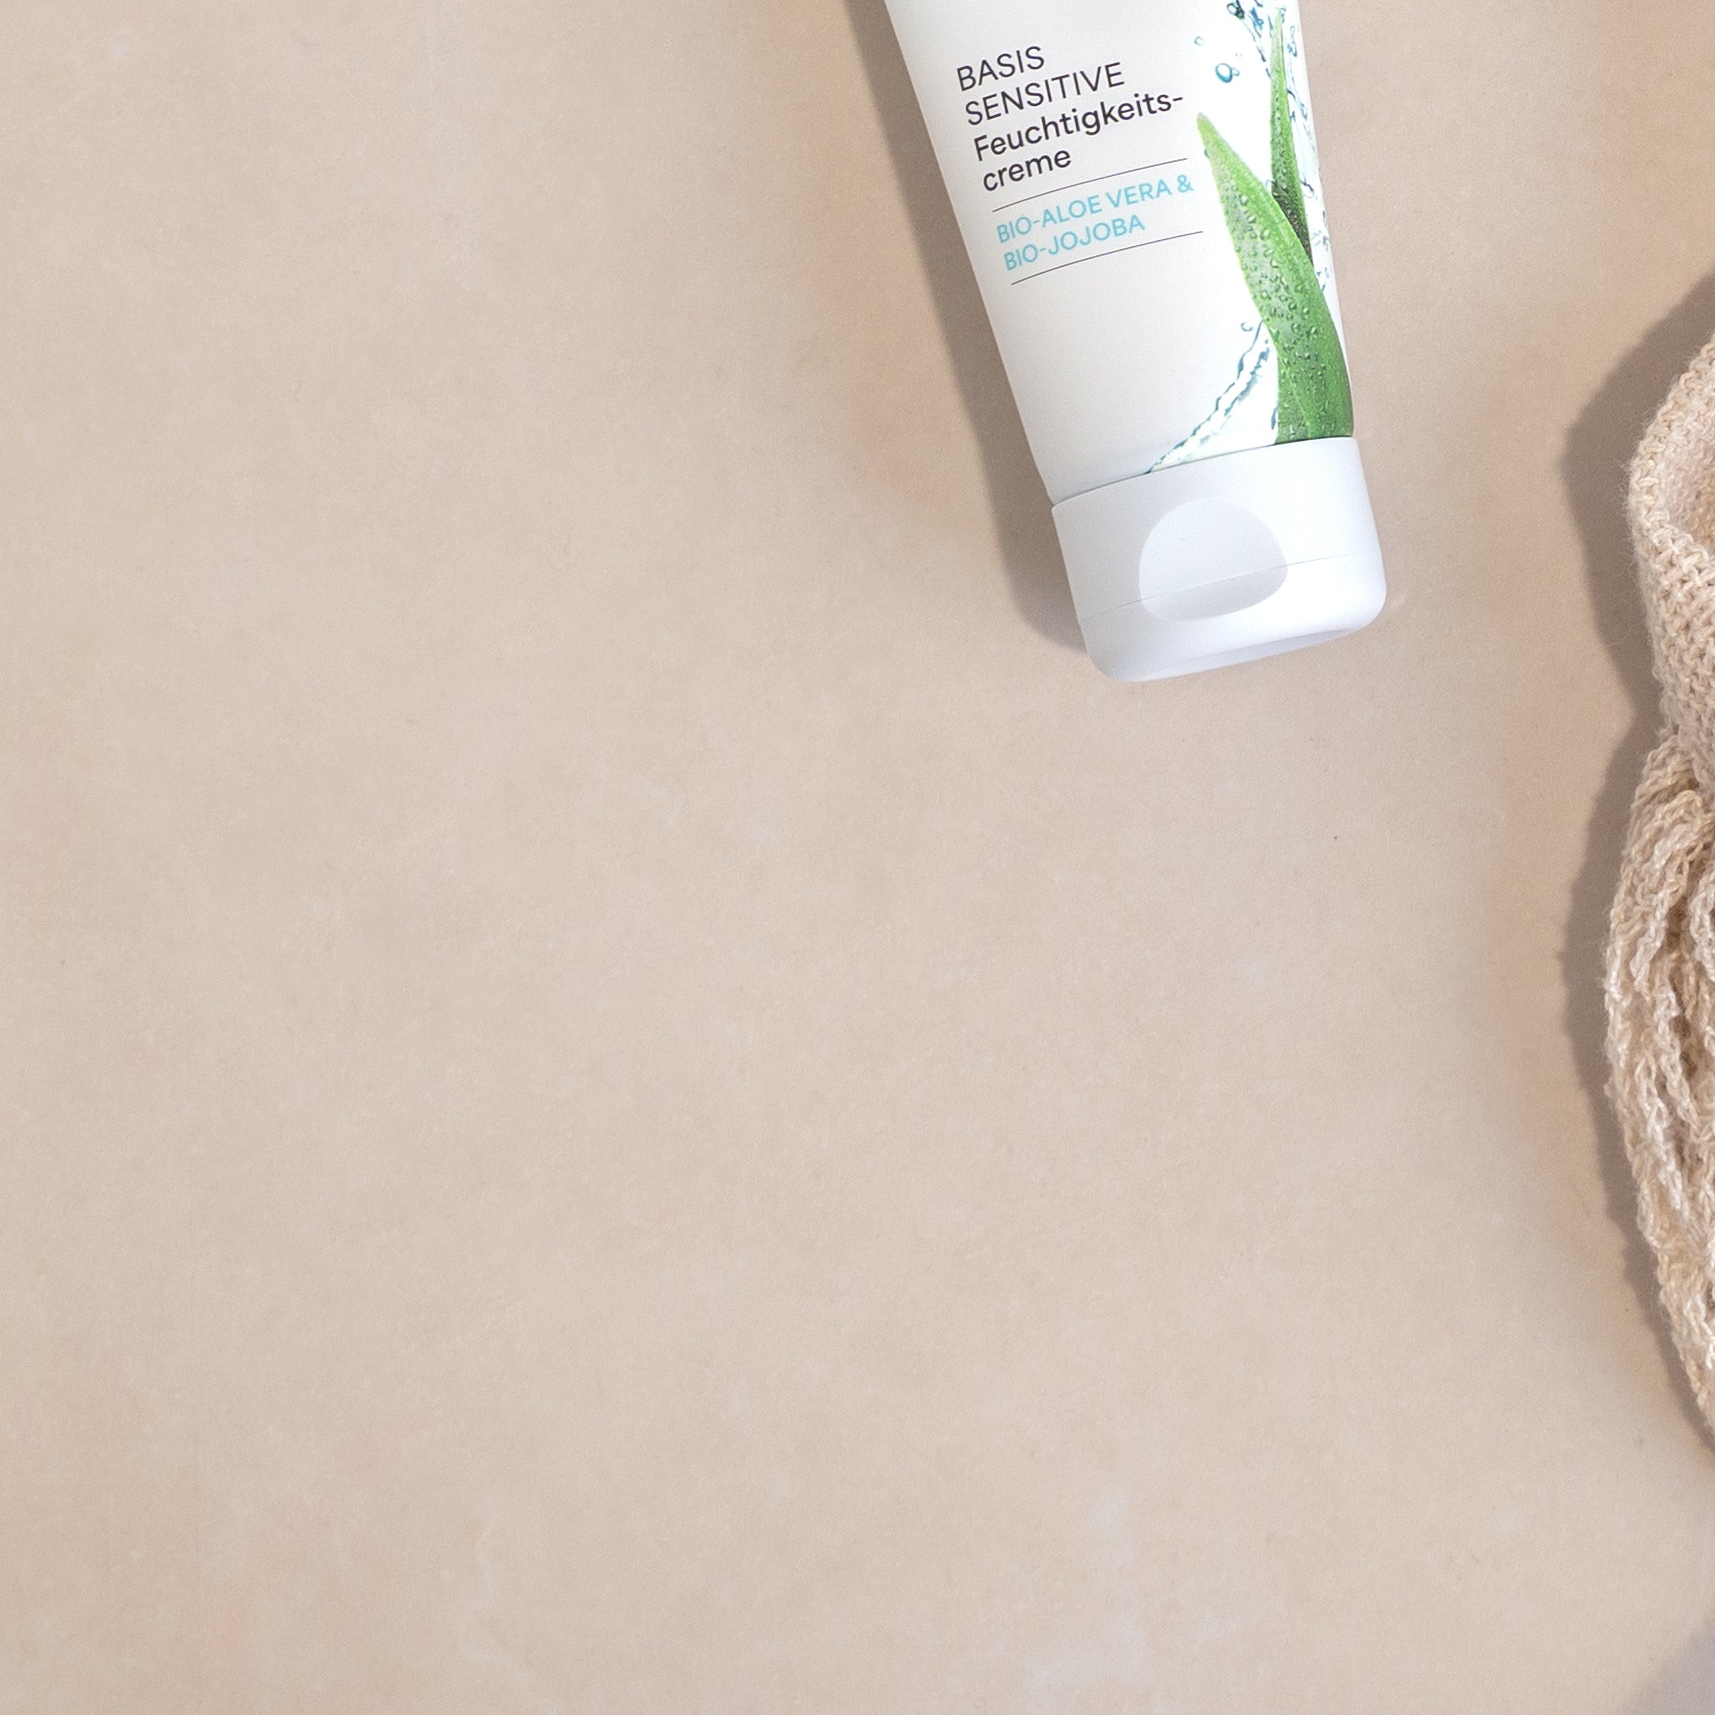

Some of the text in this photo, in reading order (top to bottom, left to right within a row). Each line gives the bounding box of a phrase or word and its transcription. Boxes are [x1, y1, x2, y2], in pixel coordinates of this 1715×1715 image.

[957, 46, 1045, 91] BASIS
[965, 62, 1125, 126] SENSITIVE
[974, 92, 1184, 162] Feuchtigkeits-
[983, 150, 1072, 192] creme
[996, 174, 1194, 244] BIO-ALOE VERA &
[1004, 214, 1146, 271] BIO-JOJOBA
